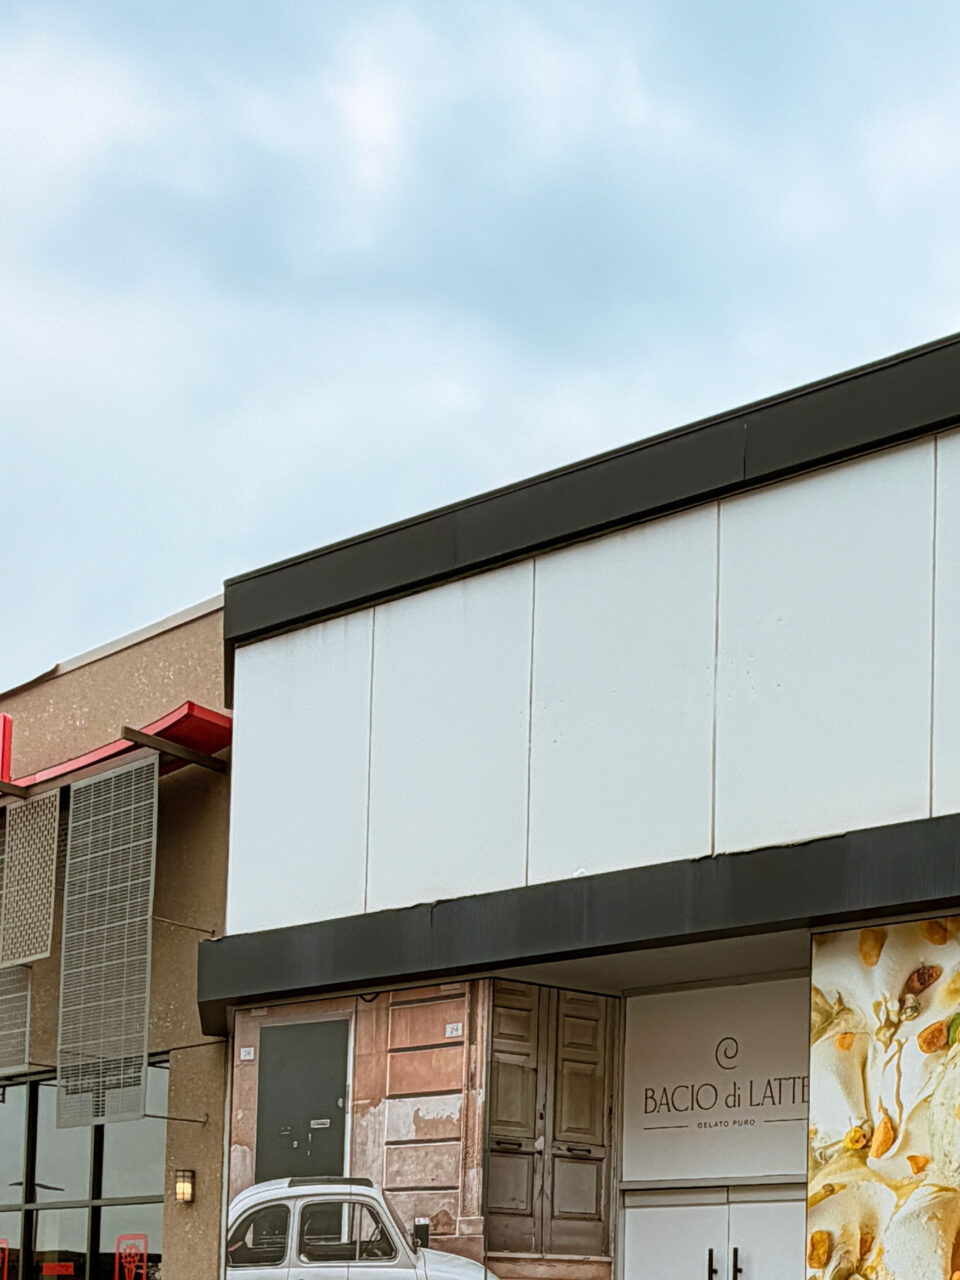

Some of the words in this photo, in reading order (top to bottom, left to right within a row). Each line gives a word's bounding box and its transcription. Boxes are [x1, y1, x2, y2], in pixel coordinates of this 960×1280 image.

[644, 1083, 718, 1114] BACIO
[725, 1082, 741, 1108] di
[697, 1120, 729, 1128] GELATO
